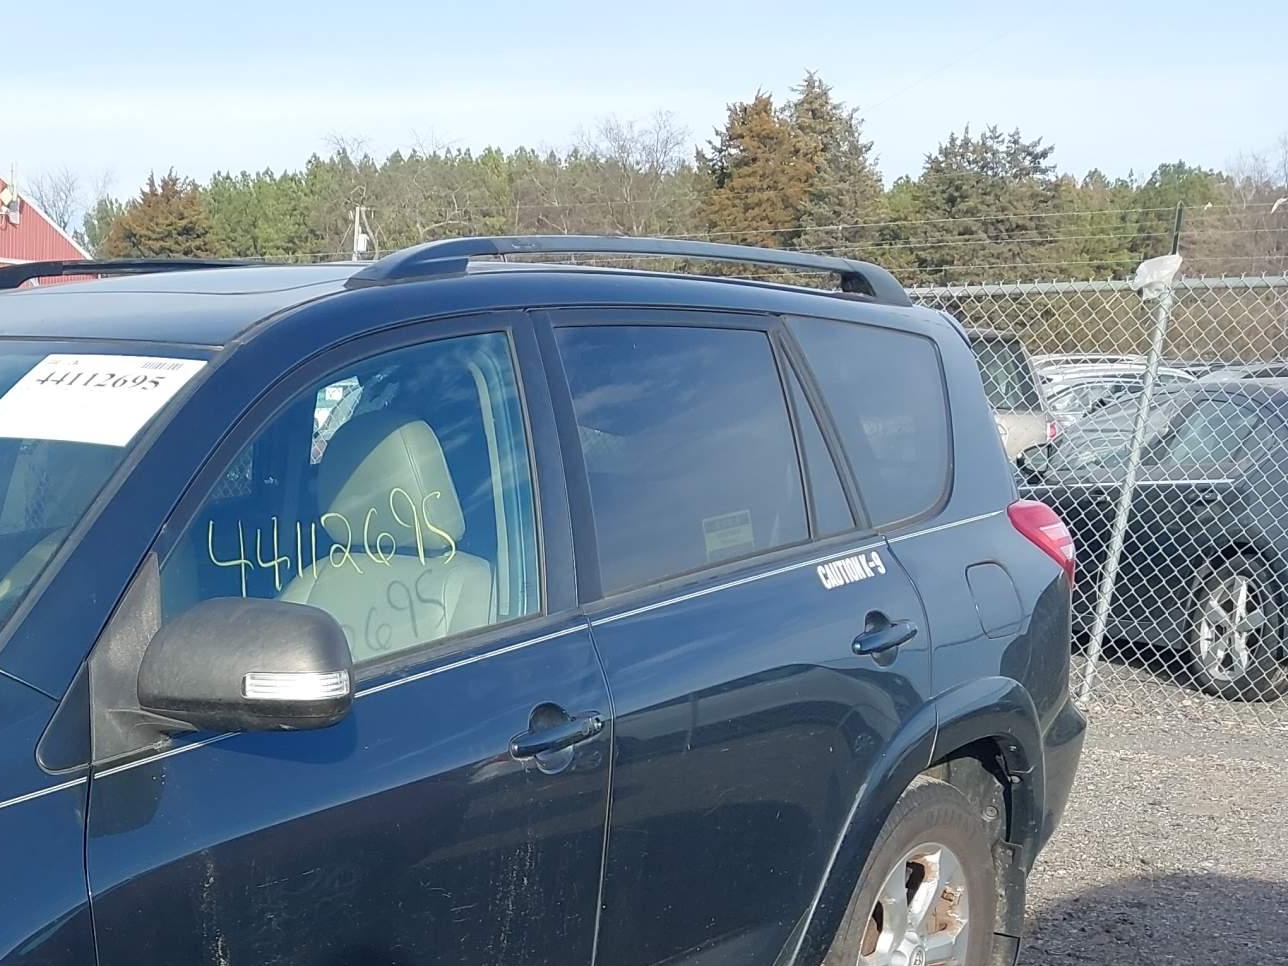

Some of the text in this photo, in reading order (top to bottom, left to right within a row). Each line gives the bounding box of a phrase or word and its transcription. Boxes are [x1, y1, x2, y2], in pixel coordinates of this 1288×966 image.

[35, 370, 167, 391] 44112695
[208, 486, 457, 598] 44112695
[817, 551, 886, 590] CAUTION K-9
